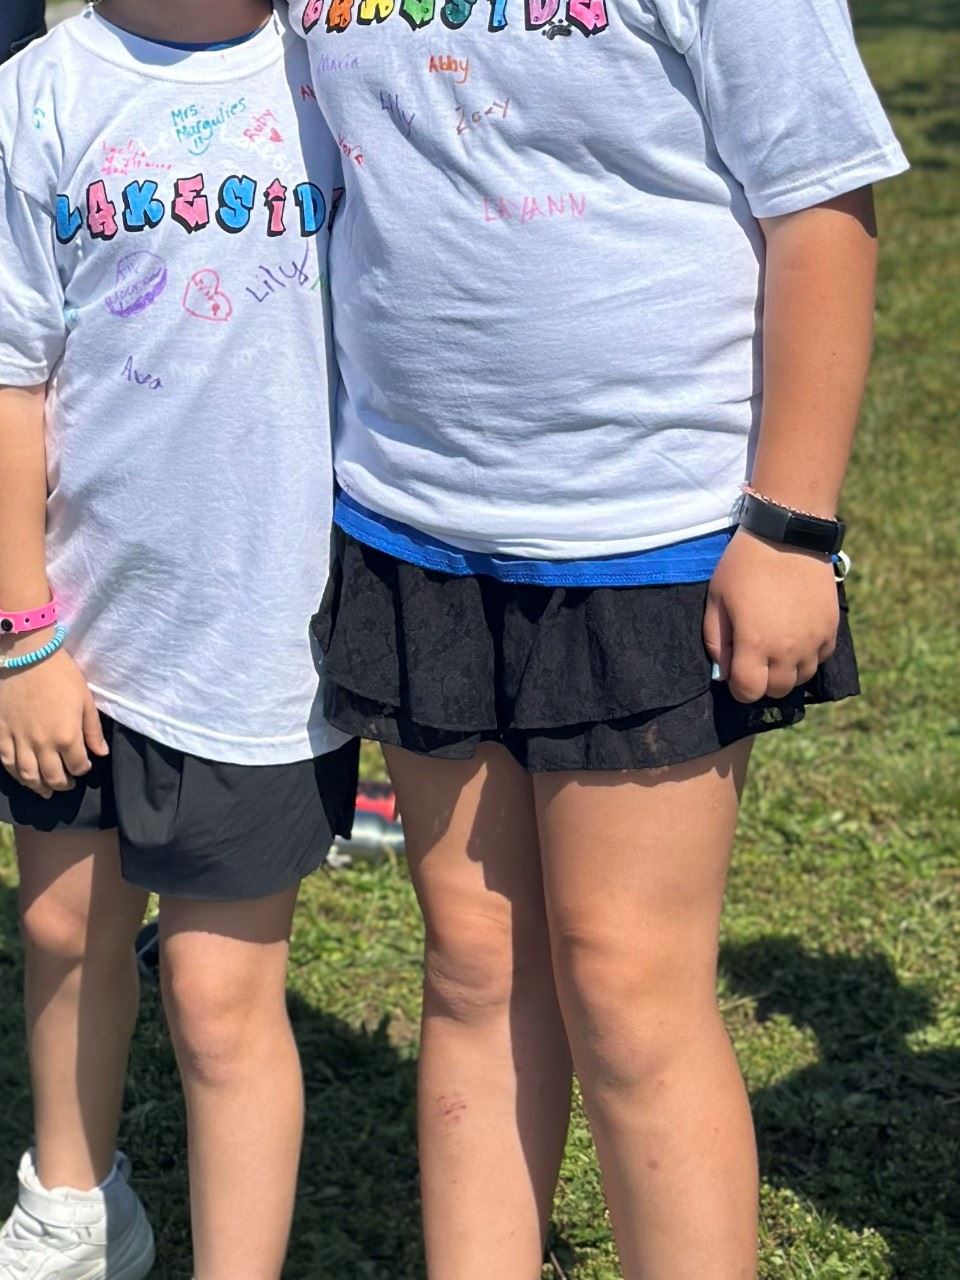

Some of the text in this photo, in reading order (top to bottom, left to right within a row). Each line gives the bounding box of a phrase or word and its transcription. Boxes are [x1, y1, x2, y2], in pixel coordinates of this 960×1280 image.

[429, 54, 469, 84] Abby
[170, 104, 199, 127] Mrs
[242, 108, 278, 142] Ruby
[55, 172, 346, 245] LAKESID
[245, 240, 309, 303] Lily
